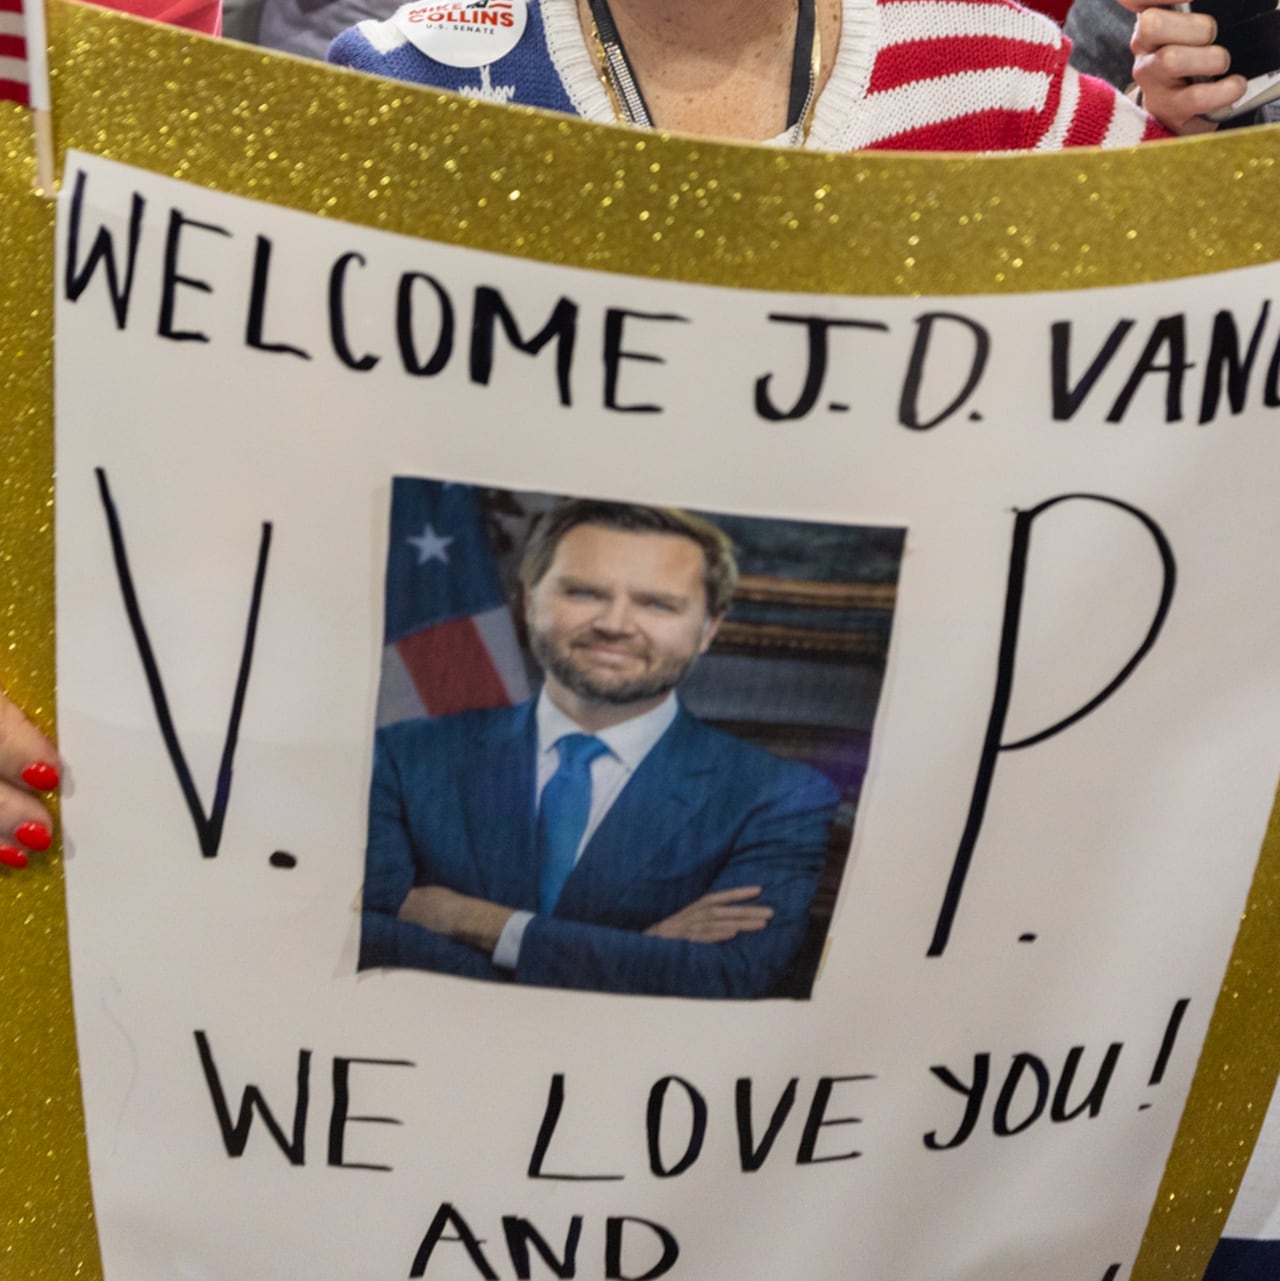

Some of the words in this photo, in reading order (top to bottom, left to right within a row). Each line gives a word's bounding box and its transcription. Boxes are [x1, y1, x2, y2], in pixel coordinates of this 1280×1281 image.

[408, 10, 514, 27] COLLINS
[409, 3, 462, 15] MIKE
[453, 24, 494, 35] SENATE
[64, 170, 694, 414] WELCOME
[753, 311, 992, 432] J.D.
[94, 466, 298, 870] V.
[925, 493, 1178, 959] P.
[193, 1030, 418, 1173] WE
[527, 1072, 877, 1183] LOVE
[409, 1202, 681, 1281] AND
